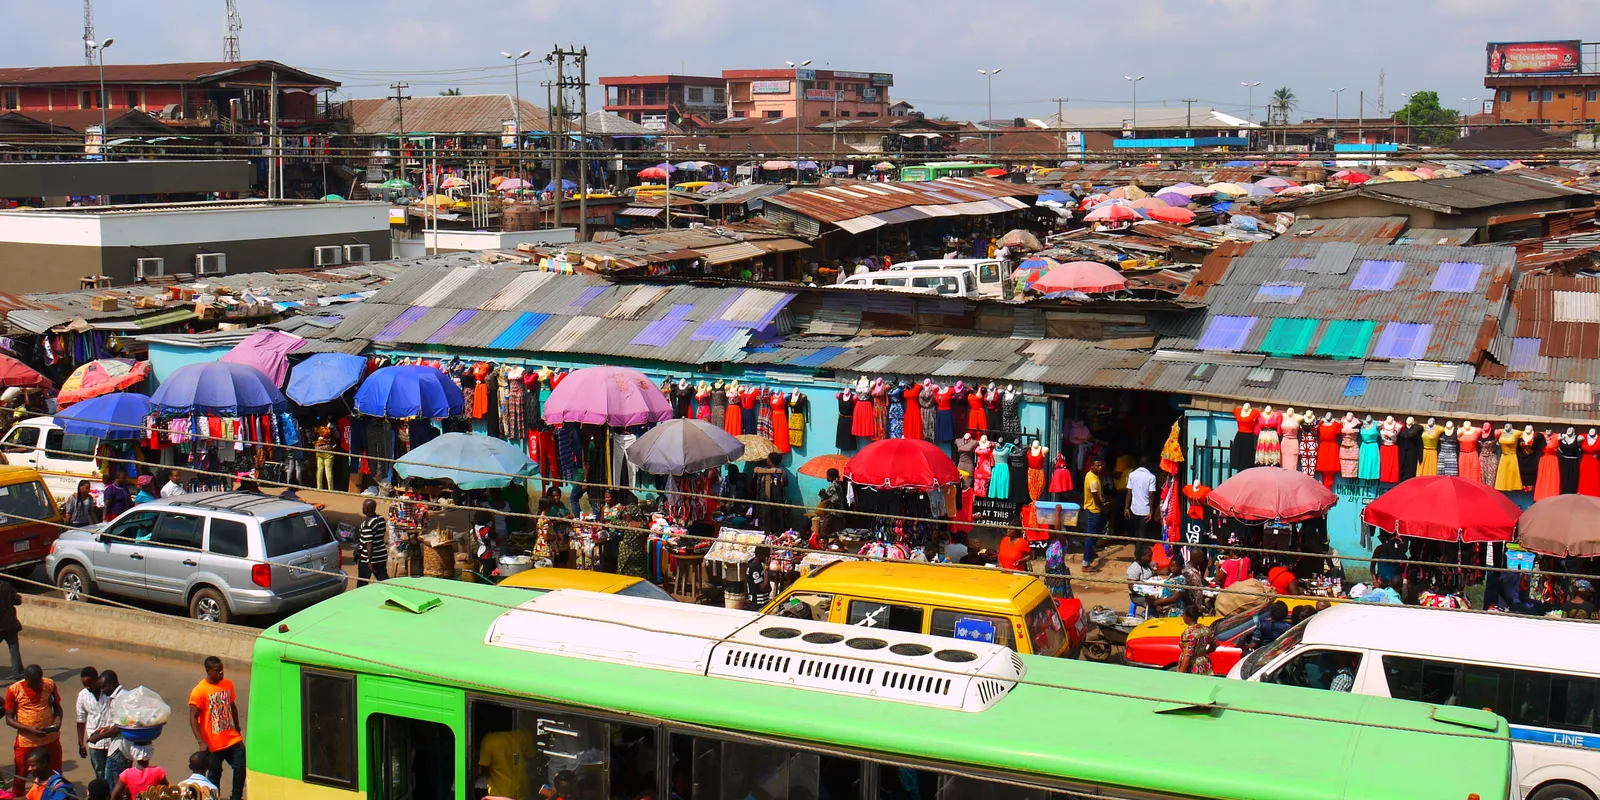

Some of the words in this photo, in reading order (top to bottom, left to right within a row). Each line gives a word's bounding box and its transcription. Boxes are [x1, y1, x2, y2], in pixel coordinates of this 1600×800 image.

[1336, 484, 1372, 497] URINATE
[982, 509, 991, 517] AT
[993, 510, 1009, 519] THIS
[1553, 733, 1584, 746] LINE
